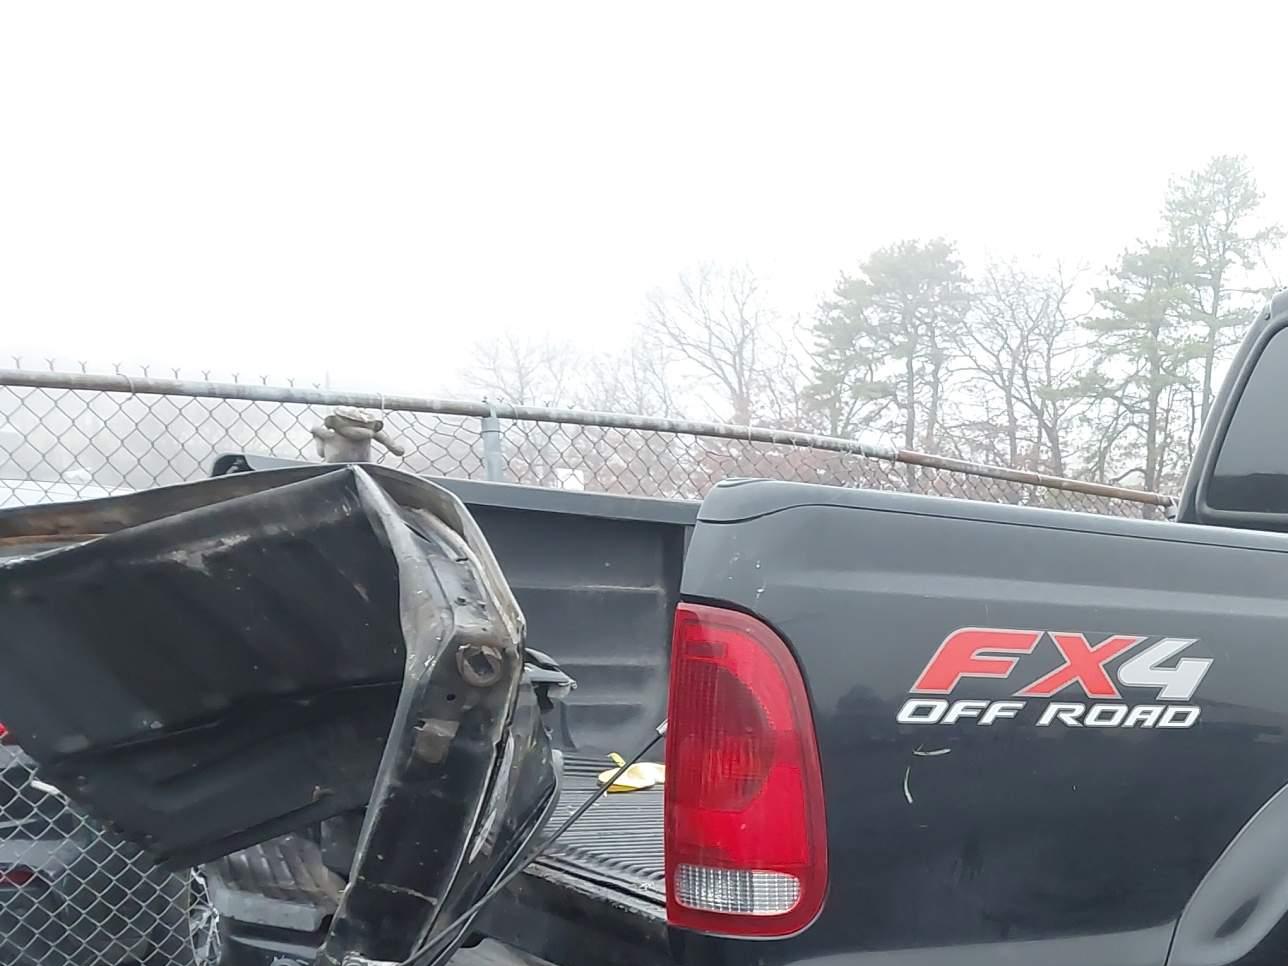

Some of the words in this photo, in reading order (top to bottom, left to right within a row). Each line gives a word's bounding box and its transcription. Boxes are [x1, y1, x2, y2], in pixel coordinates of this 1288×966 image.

[909, 626, 1214, 701] FX4
[896, 698, 1027, 726] OFF
[1035, 702, 1201, 729] ROAD
